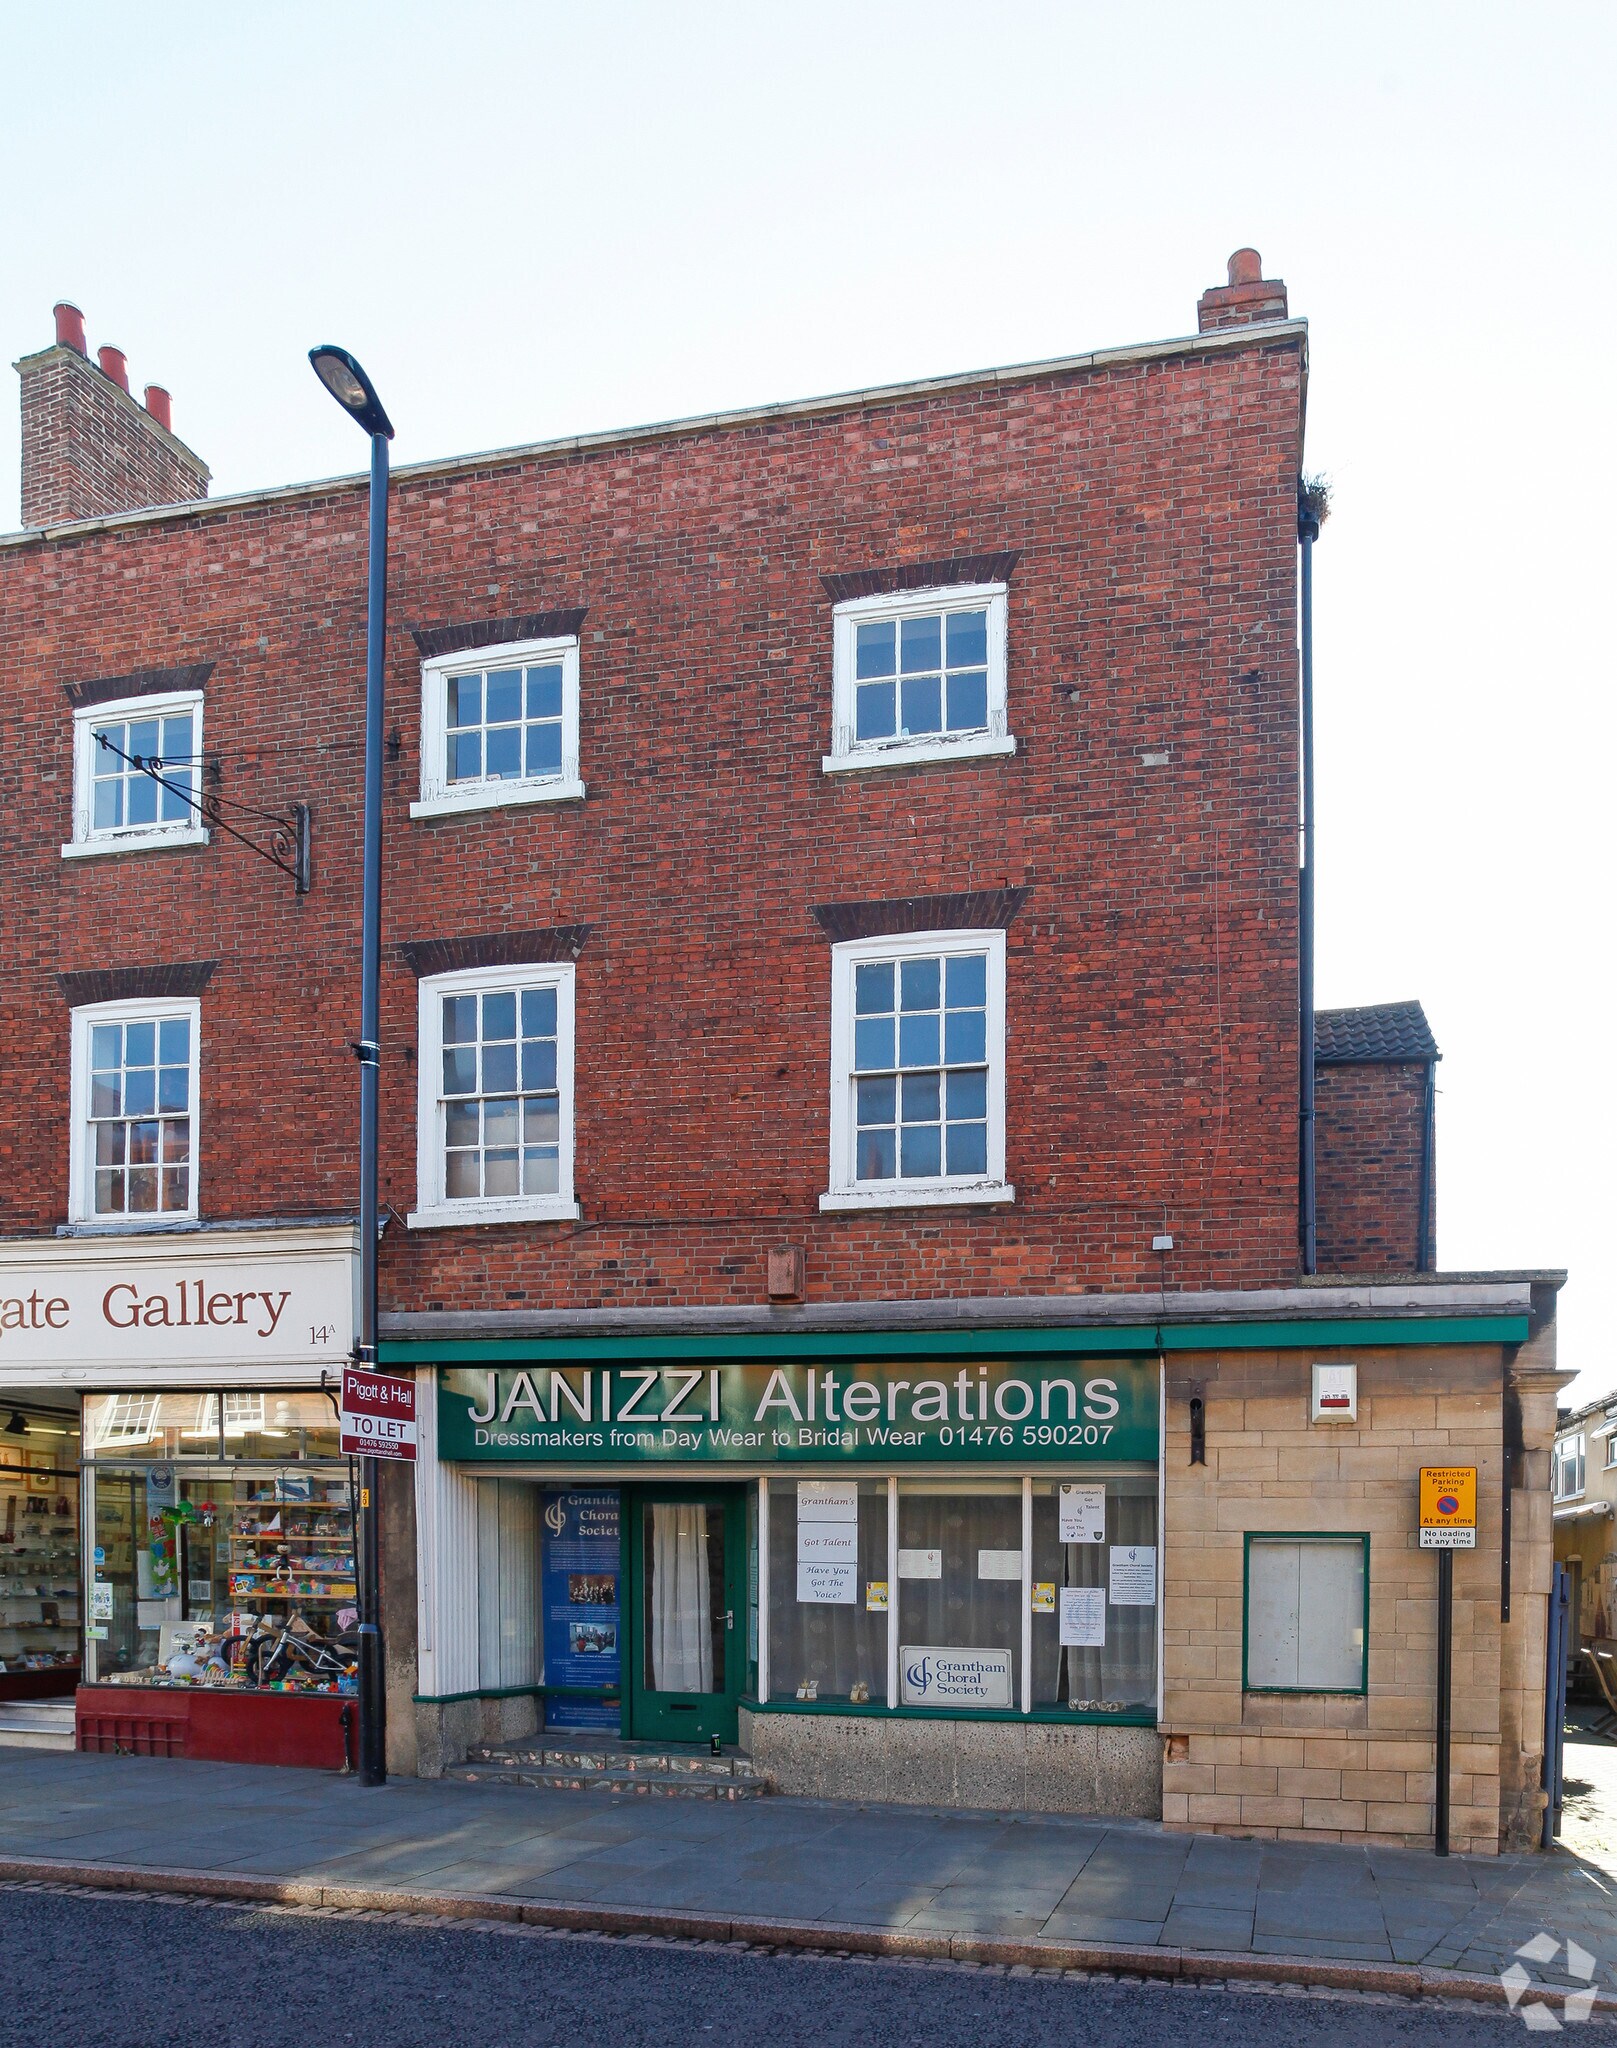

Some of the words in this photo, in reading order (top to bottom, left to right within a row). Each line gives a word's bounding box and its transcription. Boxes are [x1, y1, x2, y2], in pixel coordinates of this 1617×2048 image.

[0, 1288, 70, 1339] ate
[102, 1279, 292, 1337] Gallery
[347, 1376, 379, 1400] Pigott
[379, 1385, 388, 1401] &
[391, 1385, 412, 1405] Hall
[467, 1369, 721, 1424] JANIZZI
[753, 1366, 1120, 1422] Alterations
[352, 1416, 373, 1434] TO
[378, 1420, 406, 1438] LET
[359, 1438, 378, 1447] 01476
[474, 1428, 603, 1447] Dressmakers
[609, 1428, 659, 1447] from
[662, 1428, 703, 1450] Day
[709, 1428, 766, 1447] Wear
[771, 1429, 791, 1446] to
[798, 1427, 860, 1446] Bridal
[866, 1427, 926, 1446] Wear
[938, 1426, 1014, 1445] 01476
[1022, 1425, 1114, 1445] 590207
[1432, 1478, 1465, 1486] Parking
[801, 1496, 855, 1507] Grantham's
[1439, 1530, 1471, 1538] loading
[804, 1538, 820, 1547] Got
[823, 1537, 852, 1547] Talent
[806, 1566, 830, 1575] Have
[832, 1567, 850, 1576] You
[811, 1579, 826, 1587] Got
[828, 1578, 844, 1587] The
[814, 1590, 842, 1599] Voice?
[935, 1659, 1006, 1673] Grantham
[936, 1671, 981, 1683] Choral
[936, 1683, 989, 1698] Society
